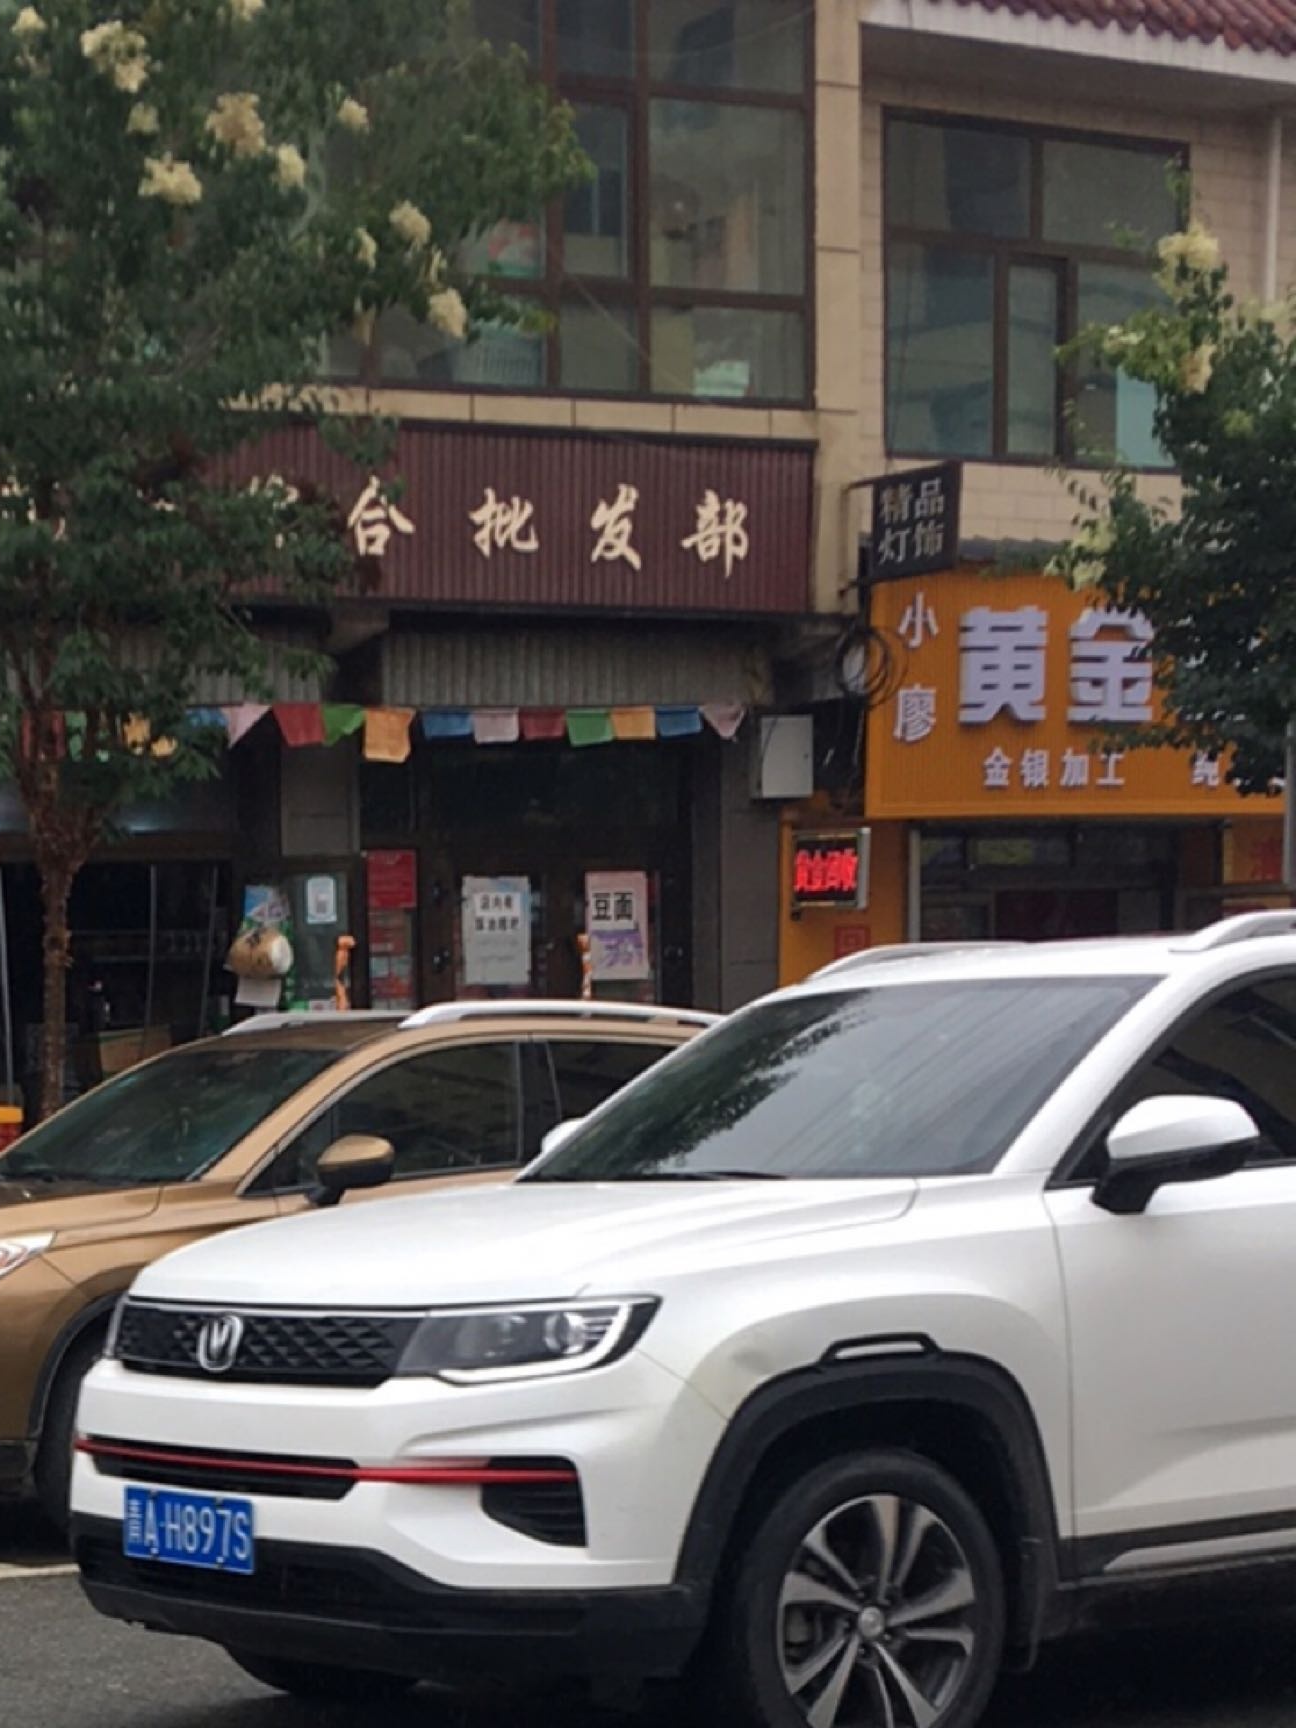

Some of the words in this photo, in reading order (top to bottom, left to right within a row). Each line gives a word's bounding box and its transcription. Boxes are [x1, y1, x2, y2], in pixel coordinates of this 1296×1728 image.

[246, 474, 750, 579] 合批发部
[983, 746, 1126, 788] 金银加工
